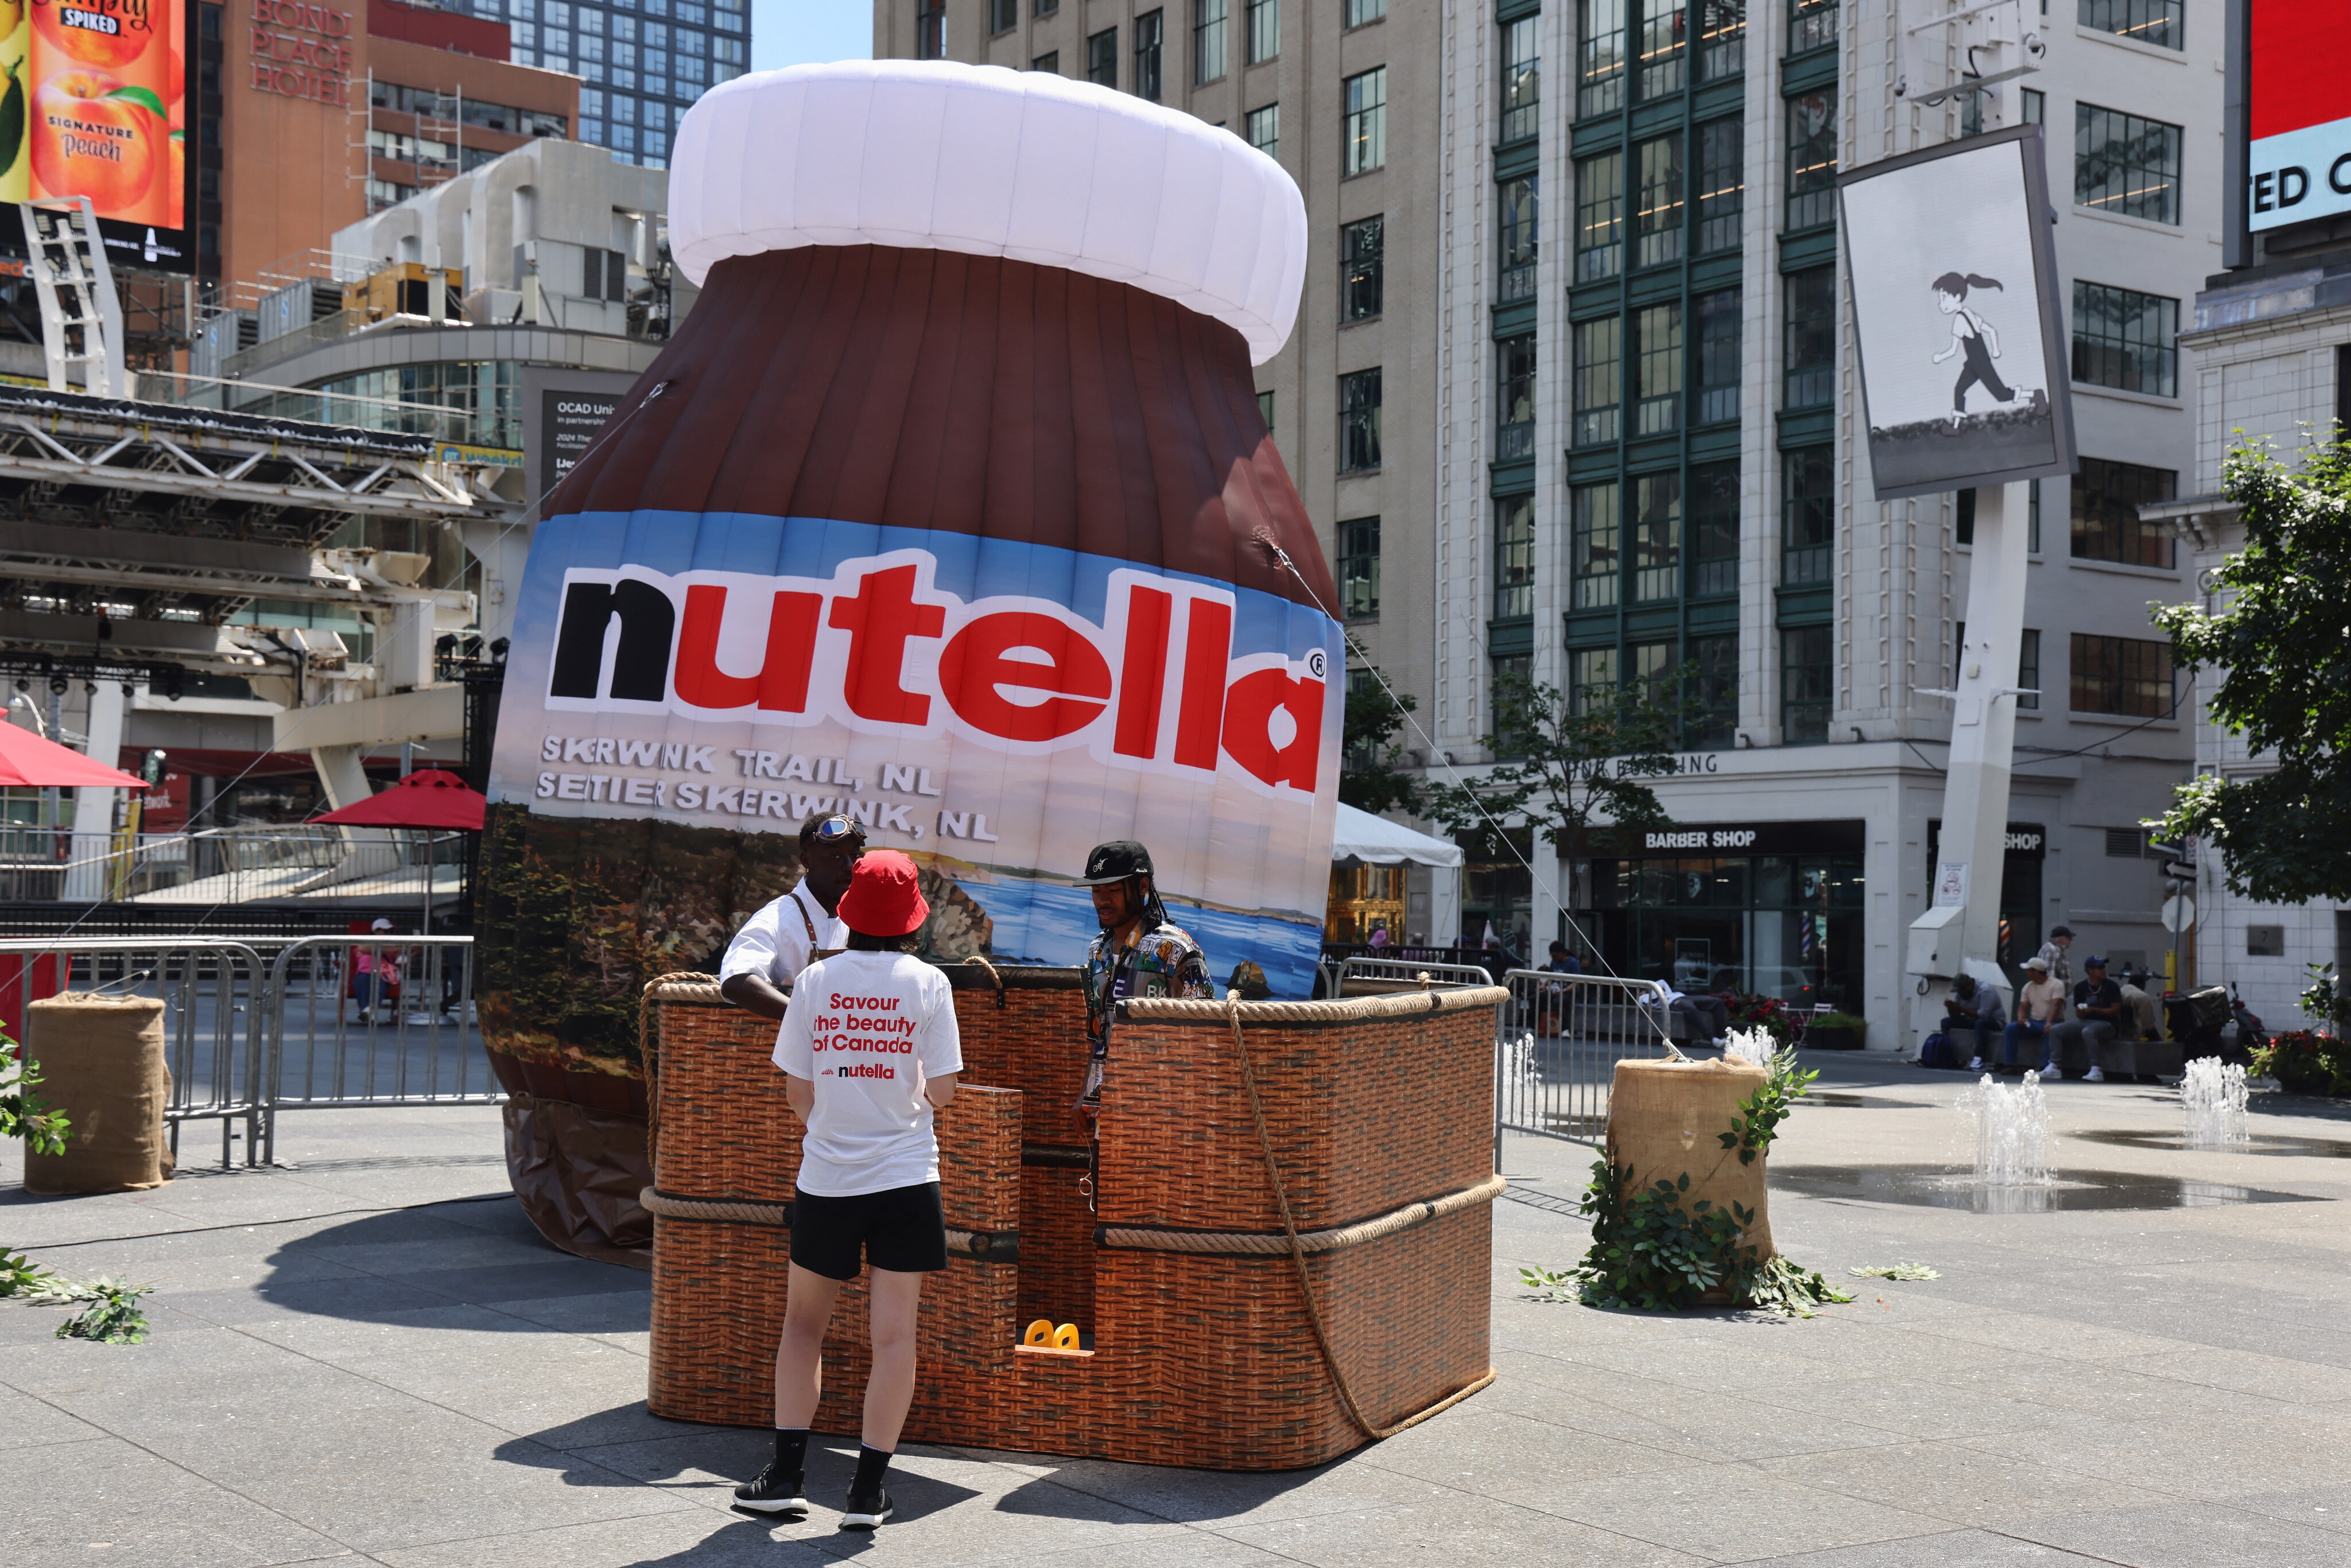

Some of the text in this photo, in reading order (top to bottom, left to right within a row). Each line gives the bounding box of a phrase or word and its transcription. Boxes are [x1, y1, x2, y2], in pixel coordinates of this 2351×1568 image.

[65, 8, 118, 34] SPIKED
[256, 0, 350, 37] BOND
[252, 29, 352, 74] PLACE
[254, 63, 351, 106] HOTEL
[49, 117, 133, 139] SIGNATURE
[61, 133, 121, 162] Peach
[2249, 166, 2308, 214] ED
[557, 402, 615, 415] OCAD Uni
[557, 416, 565, 424] in
[556, 433, 576, 442] 2024
[735, 748, 864, 792] TRAIL,
[882, 763, 942, 796] NL
[940, 809, 999, 842] NL
[1646, 830, 1756, 849] BARBER SHOP
[2004, 833, 2041, 850] SHOP
[2261, 931, 2268, 942] 7
[830, 992, 900, 1011] Savour
[847, 1014, 917, 1038] beauty
[813, 1034, 913, 1054] of Canada
[839, 1063, 894, 1080] nutella
